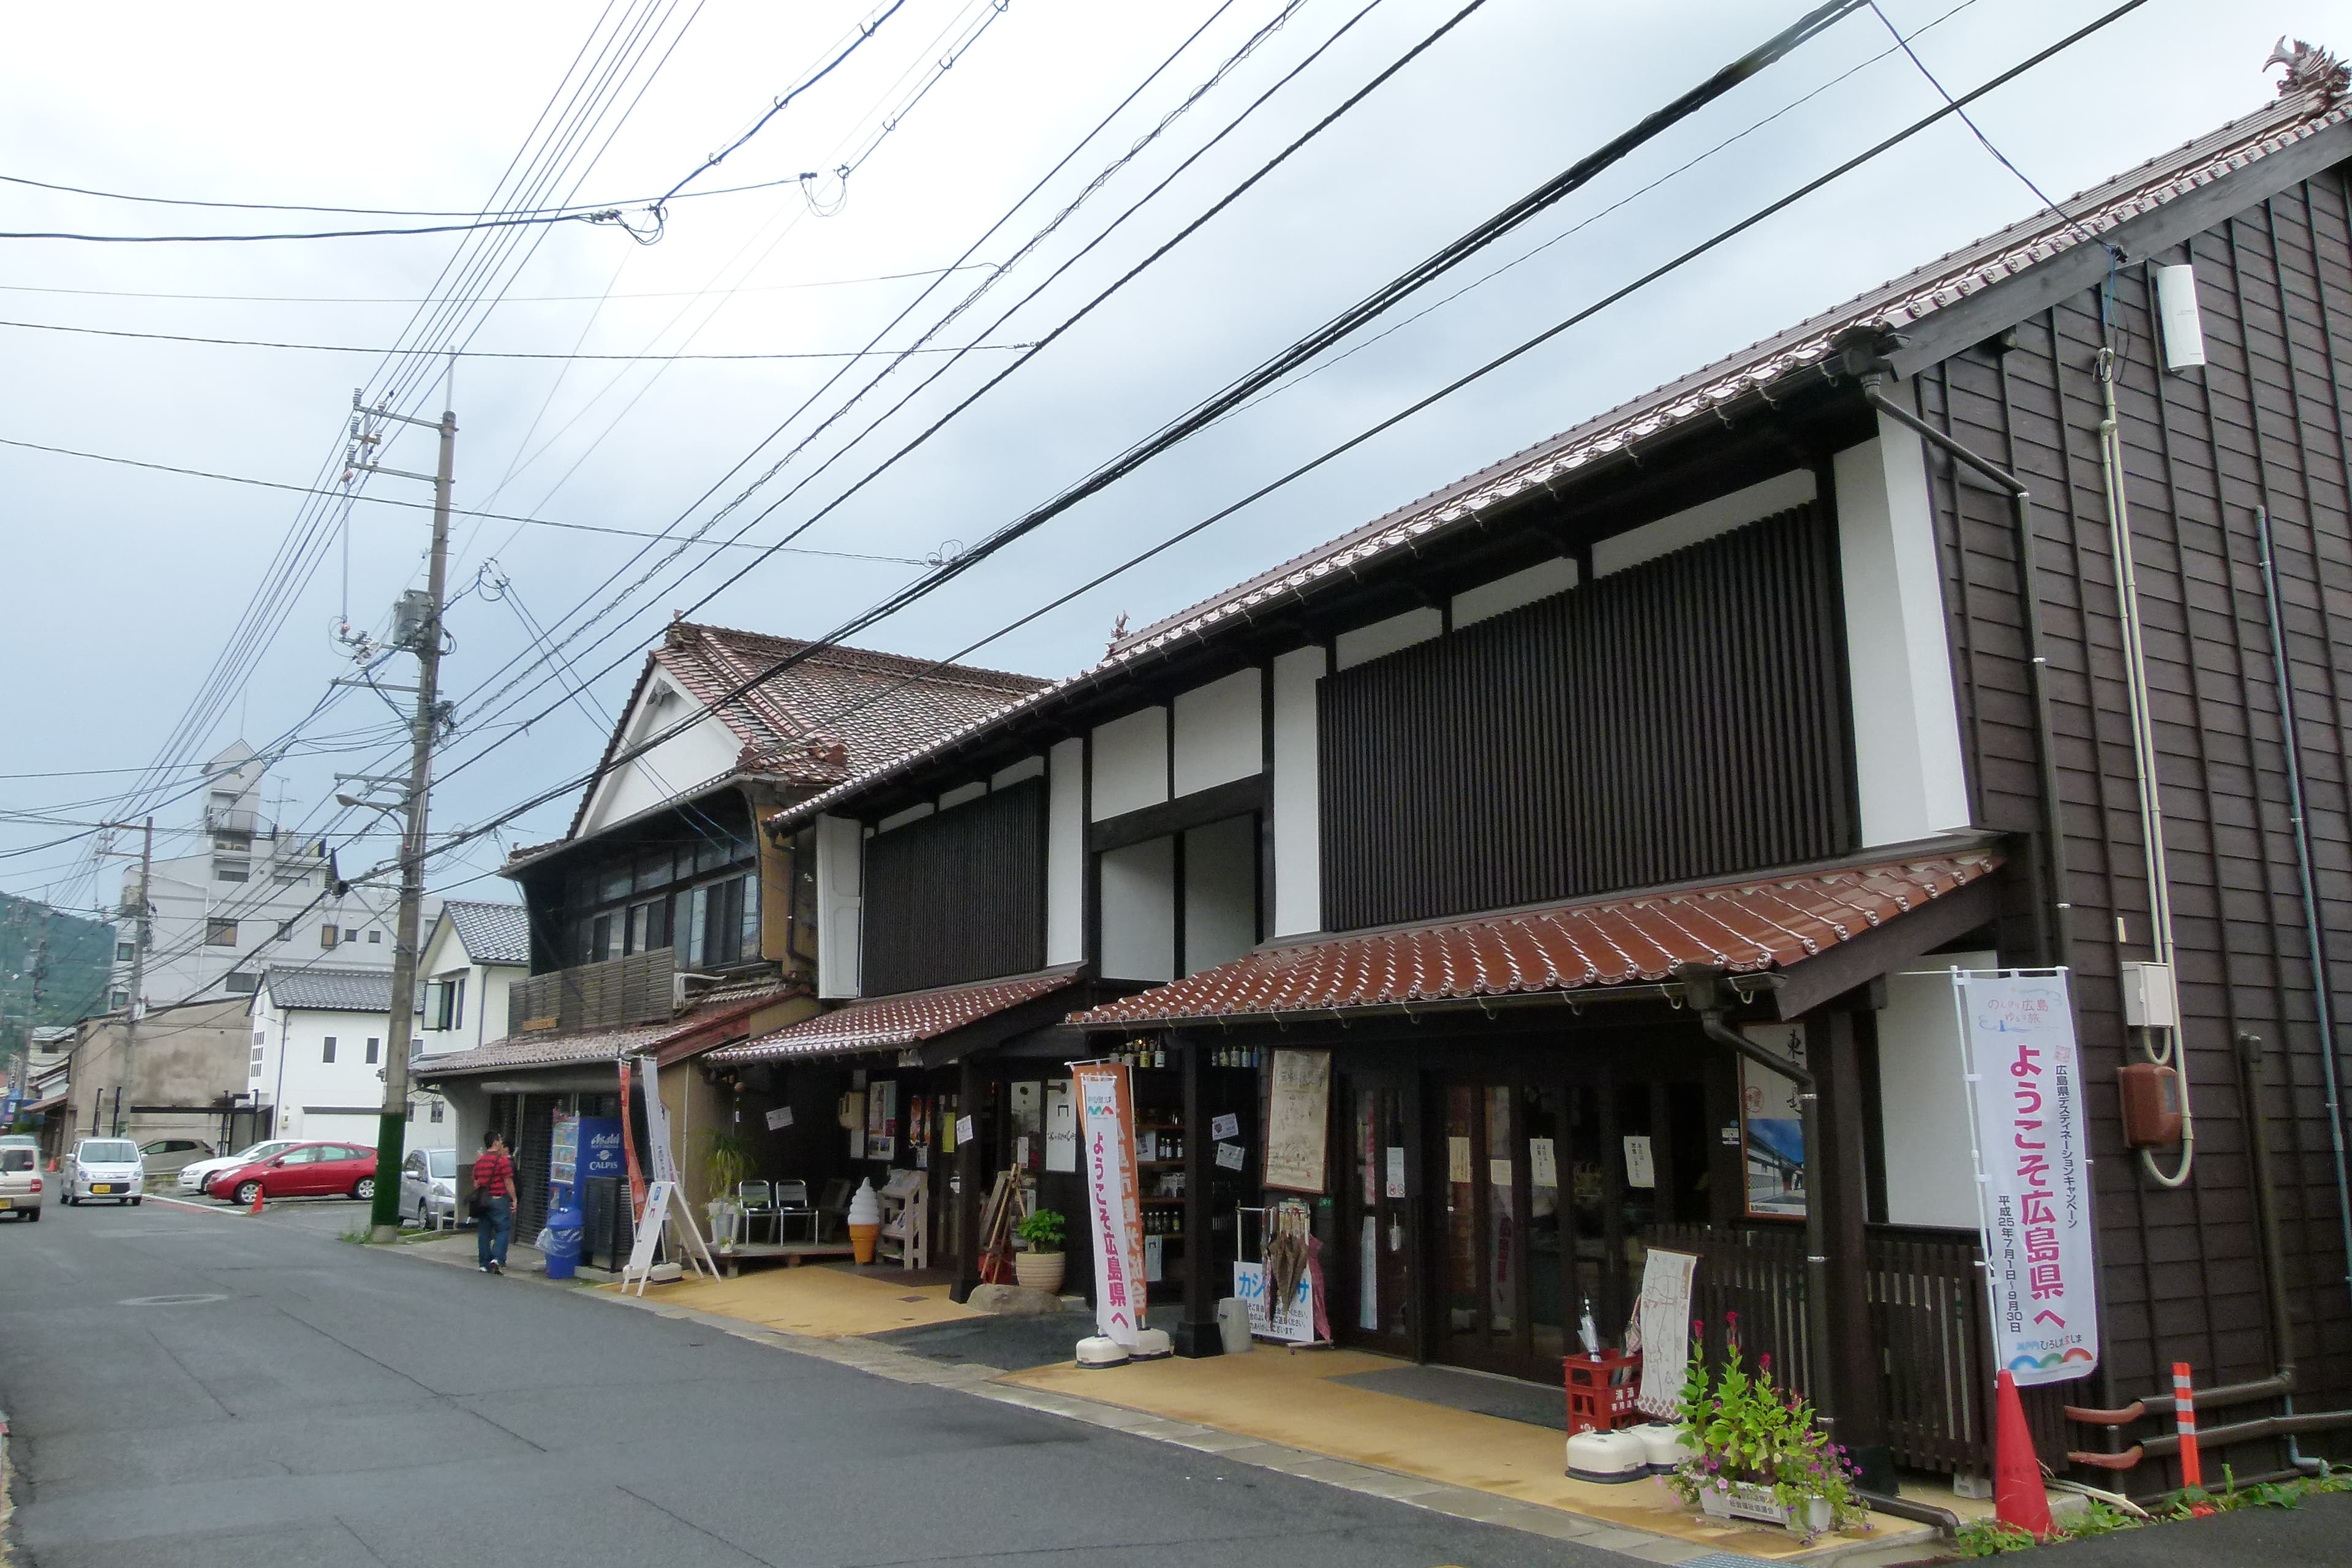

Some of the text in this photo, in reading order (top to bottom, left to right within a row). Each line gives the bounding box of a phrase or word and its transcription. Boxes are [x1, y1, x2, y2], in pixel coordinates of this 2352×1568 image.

[589, 1161, 617, 1170] CALPIS
[2010, 1044, 2067, 1329] ようこそ広島県へ
[2055, 1065, 2078, 1229] 広島県デスティネーションキャンペーン
[1093, 1131, 1129, 1329] ようこそ広島県へ
[1238, 1271, 1310, 1303] カシサ
